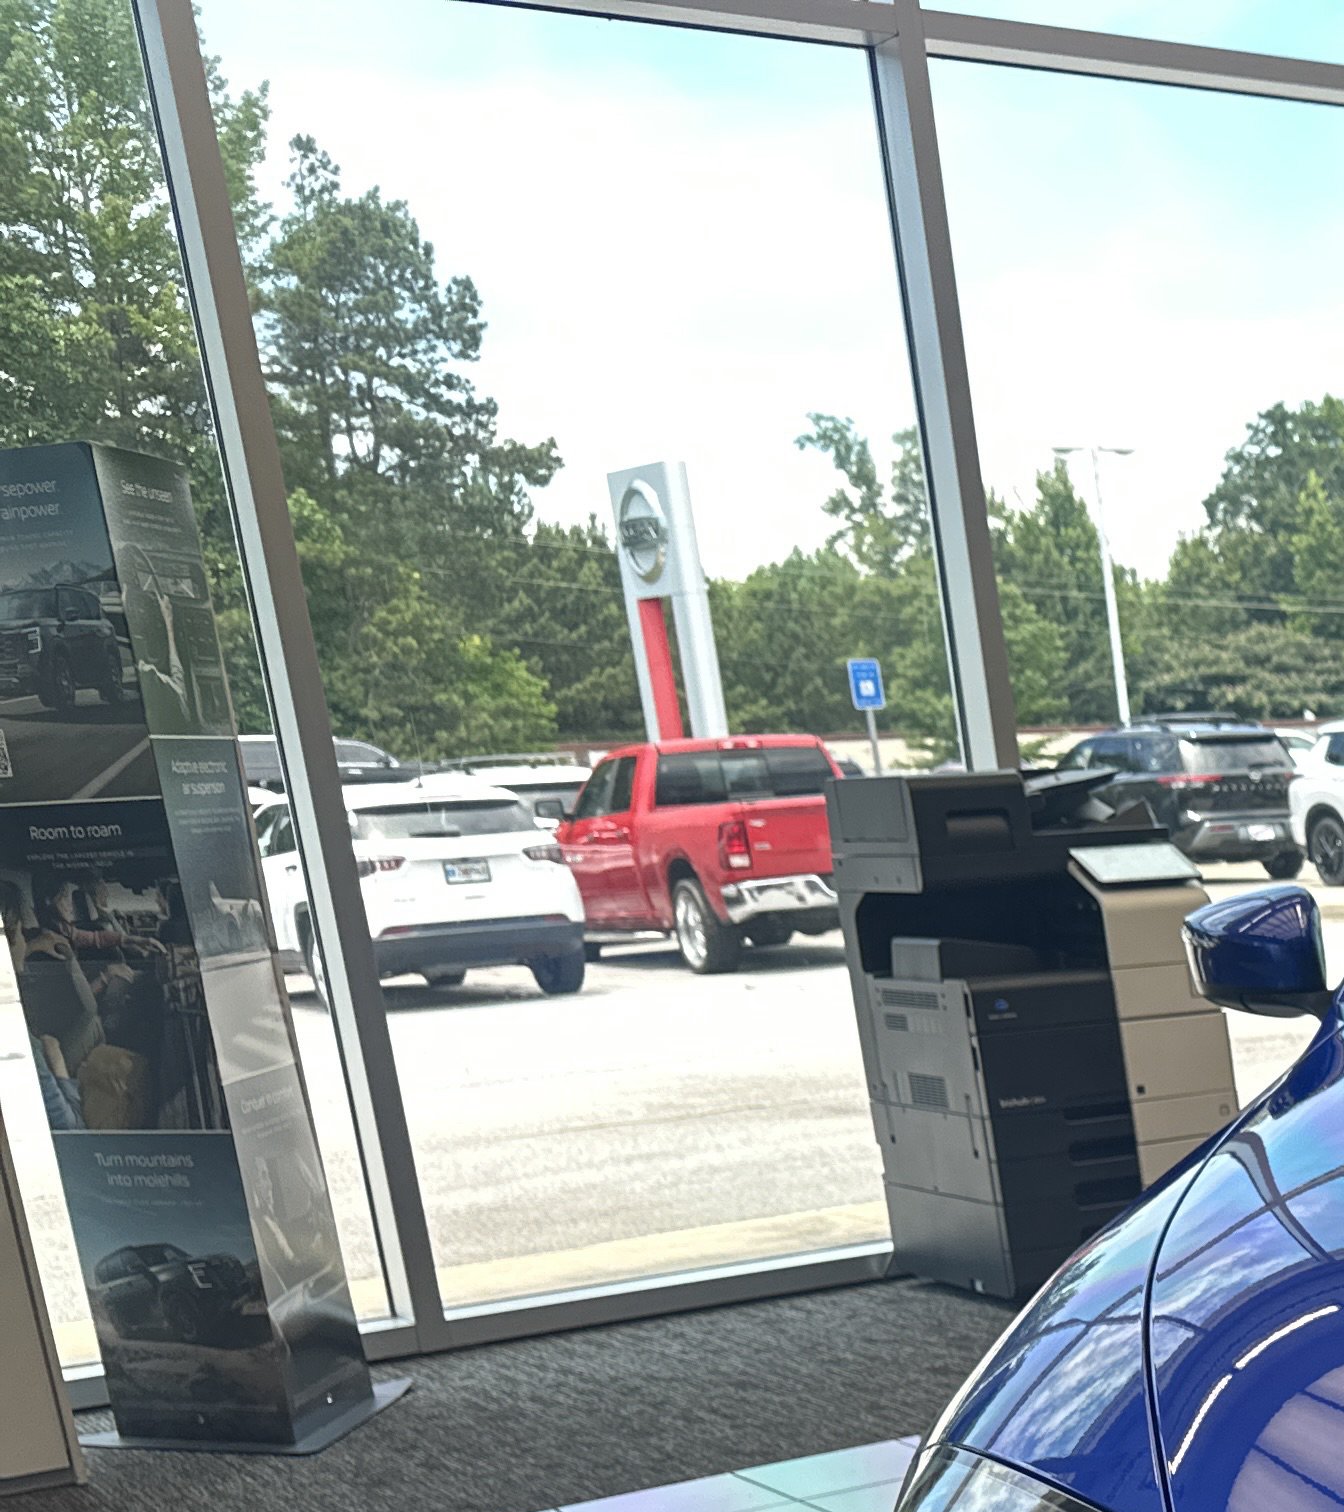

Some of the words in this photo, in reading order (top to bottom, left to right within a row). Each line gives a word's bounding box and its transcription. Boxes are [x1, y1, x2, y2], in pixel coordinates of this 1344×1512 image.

[29, 825, 70, 840] Room
[70, 825, 86, 839] to
[86, 824, 122, 838] roam
[93, 1152, 124, 1168] Turn
[124, 1152, 195, 1169] mountains
[106, 1171, 133, 1188] into
[133, 1171, 191, 1188] molehills
